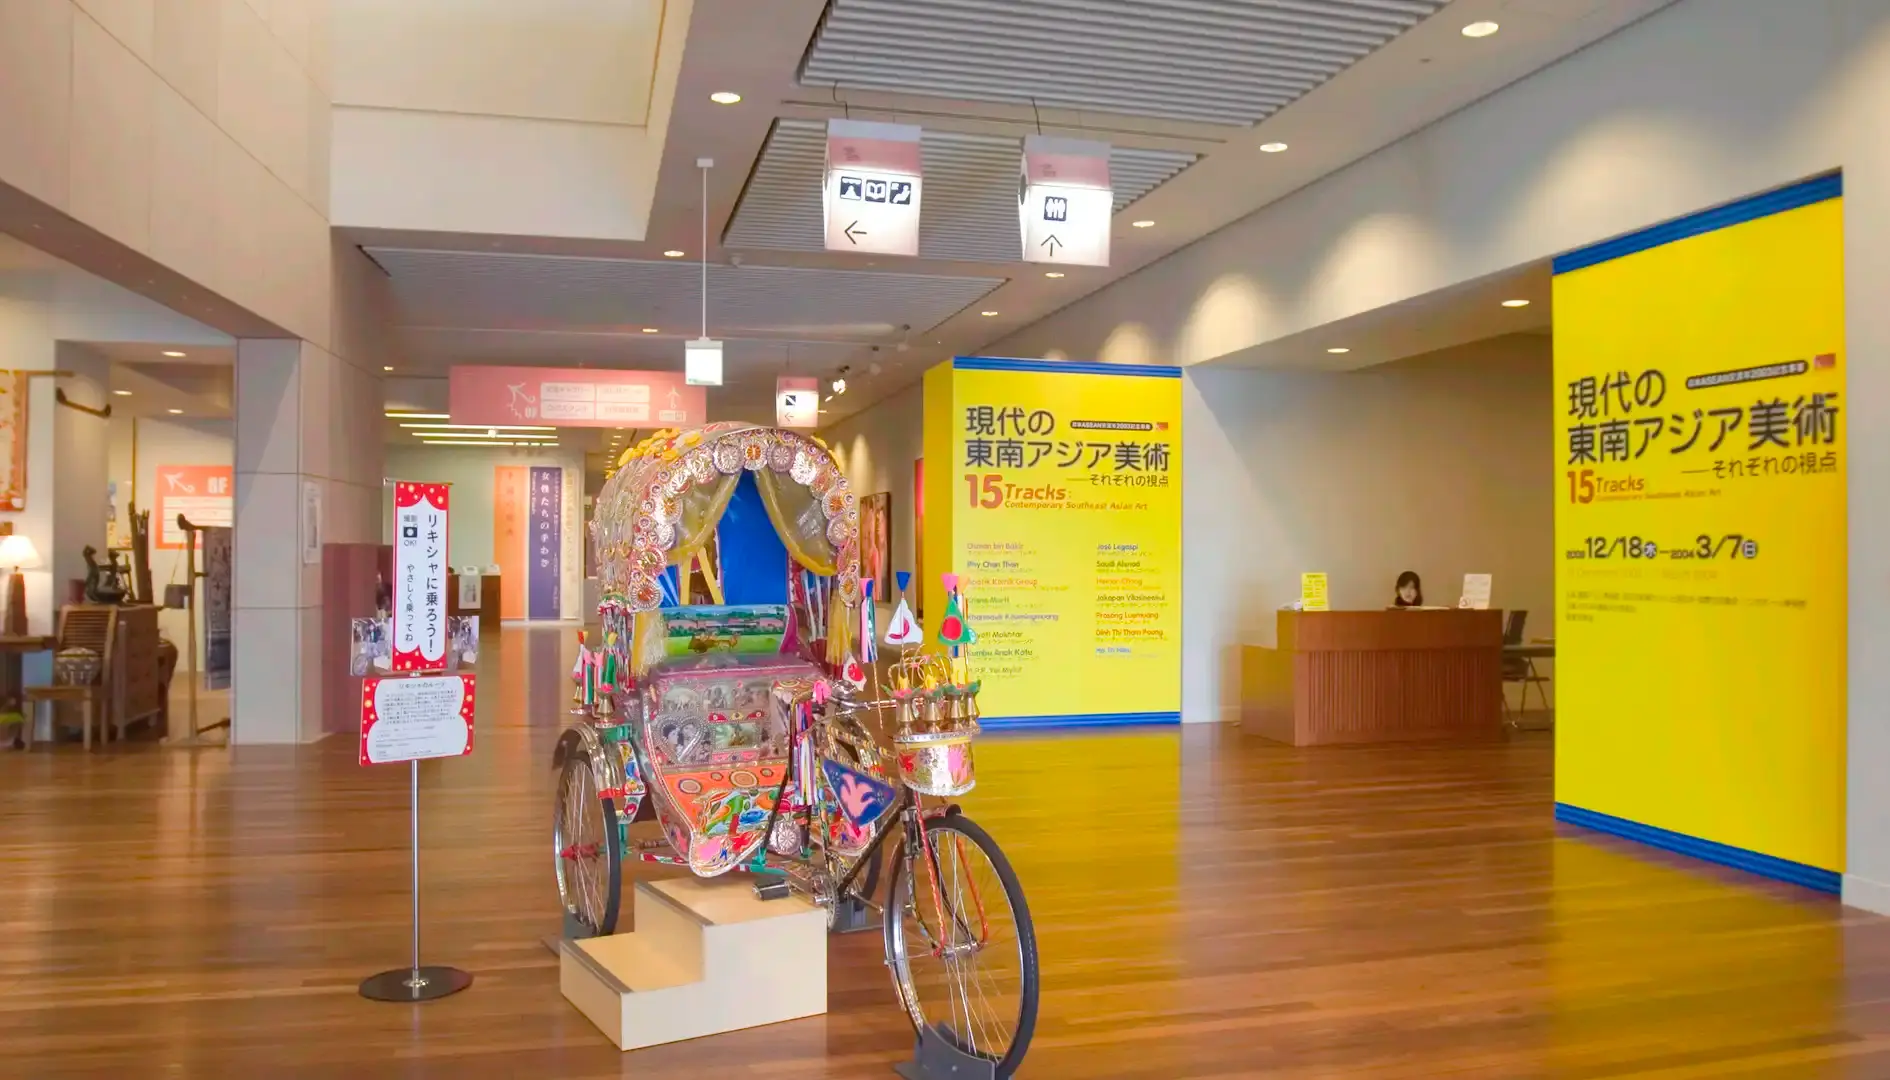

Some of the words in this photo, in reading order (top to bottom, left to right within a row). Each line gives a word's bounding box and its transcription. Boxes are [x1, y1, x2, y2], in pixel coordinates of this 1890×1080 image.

[1567, 368, 1666, 420] 現代の
[964, 405, 1055, 437] 現代の
[1567, 392, 1839, 466] 東南アジア美術
[964, 437, 1171, 472] 東南アジア美術
[964, 474, 1004, 510] 15
[1567, 469, 1595, 504] 15
[1004, 500, 1064, 511] Contemporary
[1066, 501, 1106, 510] Southeast
[1110, 501, 1132, 510] Asian
[1135, 502, 1148, 510] Art
